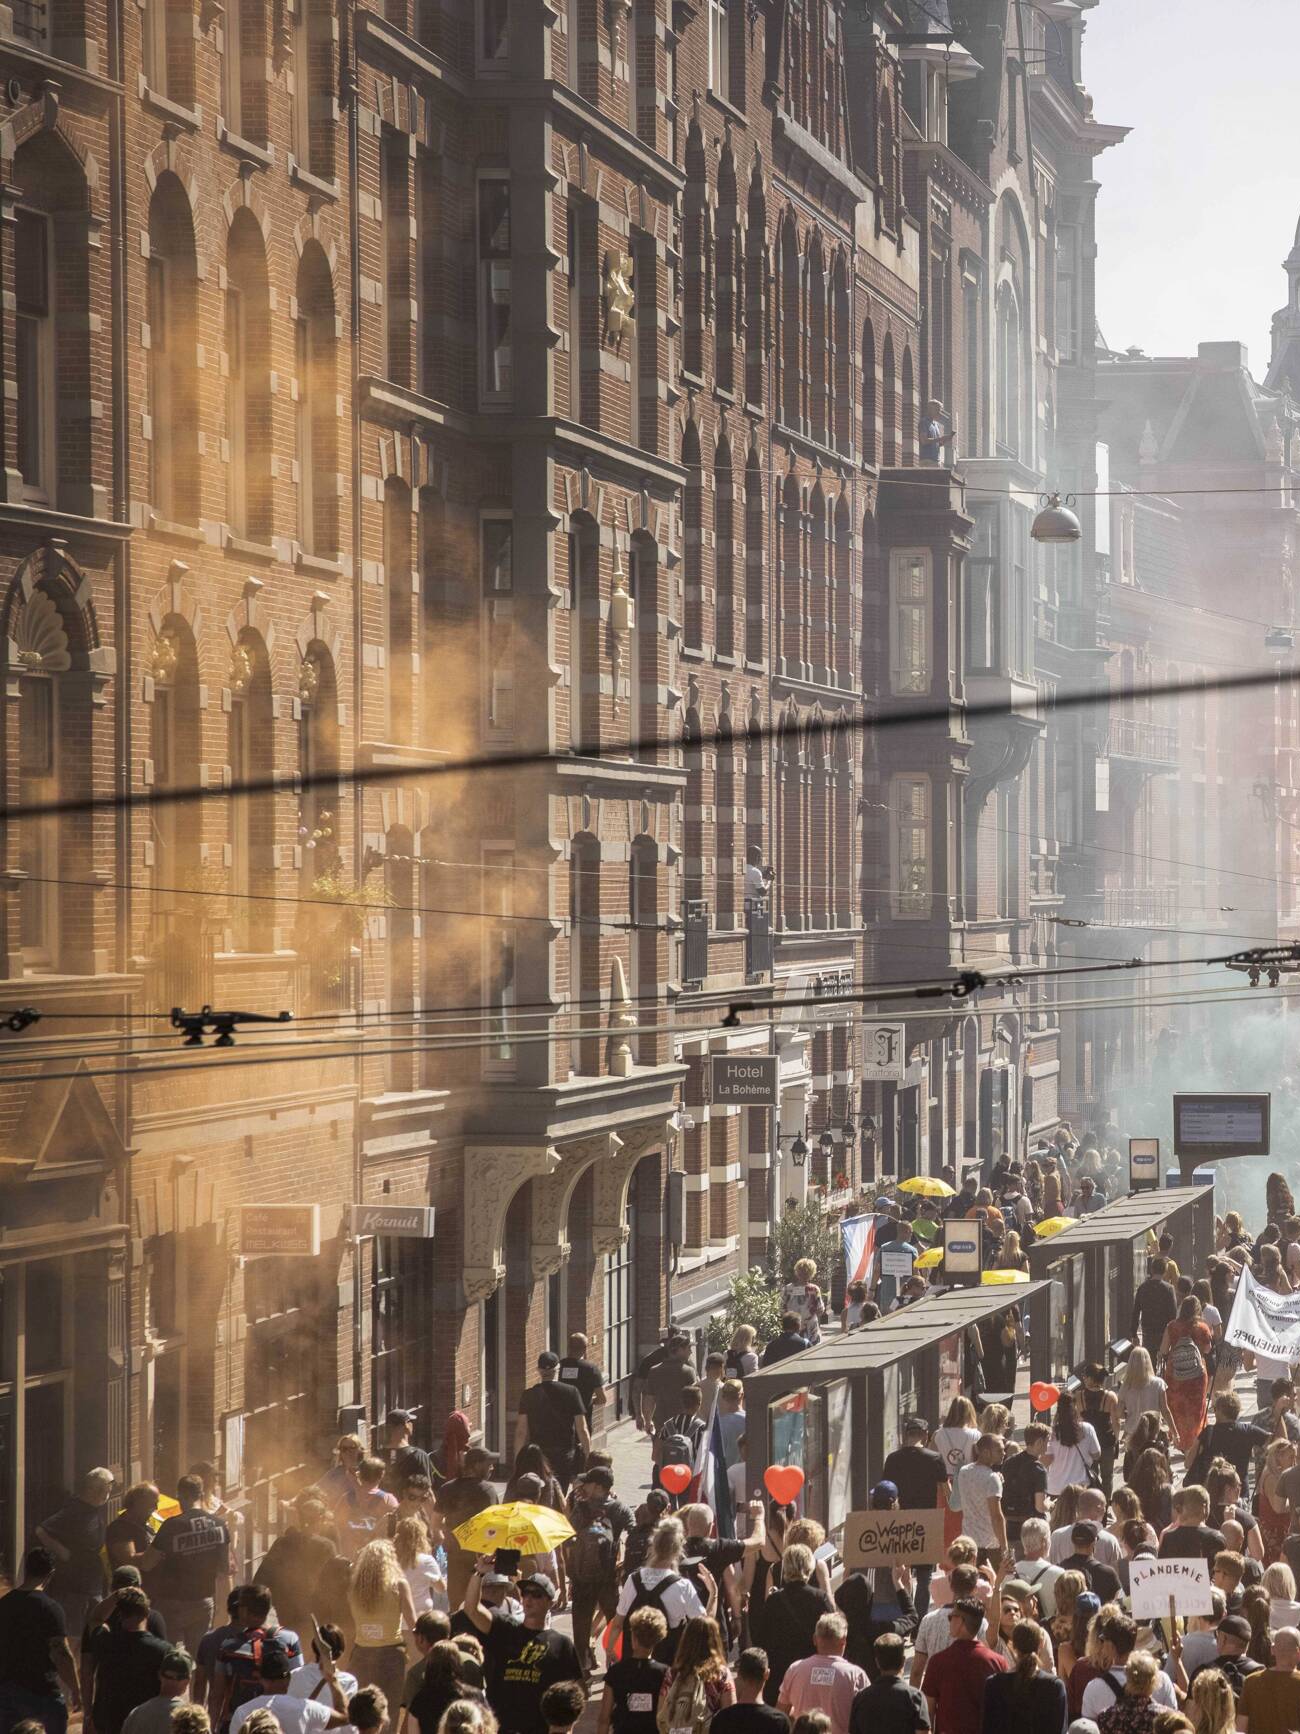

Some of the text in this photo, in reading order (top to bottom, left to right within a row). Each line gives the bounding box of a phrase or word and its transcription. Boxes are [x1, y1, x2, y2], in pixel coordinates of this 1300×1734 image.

[727, 1065, 764, 1078] Hotel
[719, 1084, 771, 1095] La Bohème
[361, 1211, 418, 1230] Kornuit
[876, 1519, 926, 1539] Wappie
[1133, 1564, 1203, 1586] PLANDEMIE
